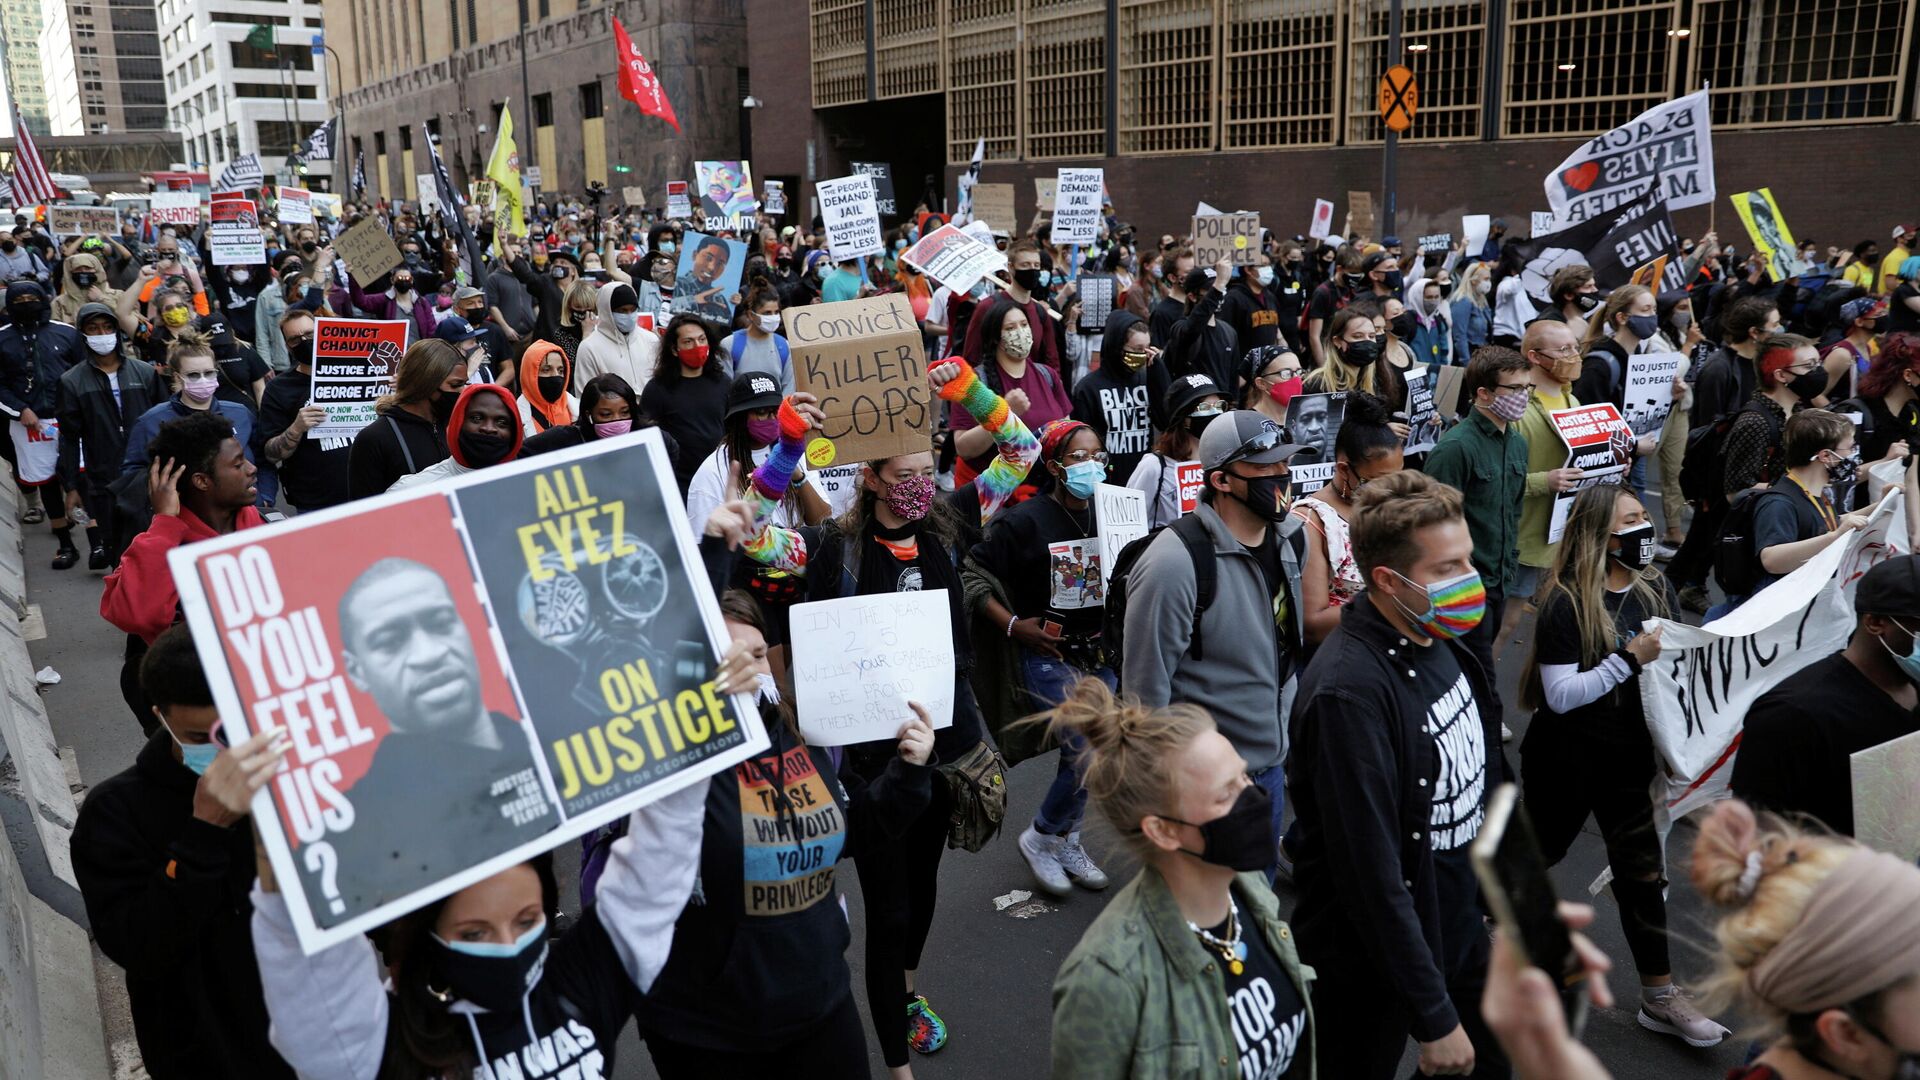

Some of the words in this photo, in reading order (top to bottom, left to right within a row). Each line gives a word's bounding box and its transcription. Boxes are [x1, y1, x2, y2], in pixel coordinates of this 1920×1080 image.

[1384, 90, 1390, 104] R
[1408, 92, 1415, 105] R
[838, 181, 868, 192] PEOPLE
[1061, 184, 1101, 192] DEMAND:
[824, 191, 872, 207] DEMAND:
[1070, 196, 1088, 205] JAIL
[152, 207, 200, 224] BREATHE
[841, 205, 863, 218] JAIL
[338, 218, 381, 250] JUSTICE
[830, 222, 854, 232] KILLER
[834, 226, 875, 242] NOTHING
[1197, 218, 1256, 238] POLICE
[853, 236, 876, 248] LESS!
[362, 254, 393, 279] FLOYD
[923, 248, 954, 271] JUSTICE
[934, 255, 966, 279] GEORGE
[321, 326, 379, 339] CONVICT
[793, 302, 903, 342] Convict
[320, 340, 380, 352] CHAUVIN
[316, 365, 364, 375] JUSTICE
[367, 365, 388, 374] FOR
[806, 345, 918, 389] KILLER
[1631, 364, 1646, 372] NO
[1648, 360, 1679, 373] JUSTICE
[1632, 377, 1646, 385] NO
[1649, 375, 1674, 384] PEACE
[315, 386, 362, 399] GEORGE
[817, 386, 925, 439] COPS
[1558, 412, 1593, 428] JUSTICE
[1590, 410, 1610, 420] FOR
[1562, 423, 1600, 439] GEORGE
[1597, 420, 1626, 432] FLOYD
[1106, 431, 1149, 454] MATTE
[1574, 450, 1614, 468] CONVICT
[819, 468, 856, 478] woma
[532, 464, 598, 520] ALL
[827, 481, 839, 491] to
[516, 500, 640, 582] EYEZ
[204, 545, 286, 628] DO
[805, 610, 840, 632] IN
[850, 606, 883, 625] THE
[890, 600, 926, 626] YEAR
[228, 605, 336, 698] YOU
[801, 664, 851, 683] WILL
[600, 657, 659, 716] ON
[828, 690, 853, 706] BE
[864, 678, 914, 699] PROUD
[813, 713, 860, 730] THEIR
[863, 708, 909, 722] FAMIL
[865, 702, 885, 714] OF
[252, 675, 374, 772] FEEL
[551, 680, 736, 800] JUSTICE
[490, 767, 537, 796] JUSTICE
[568, 784, 622, 813] JUSTICE
[626, 772, 651, 788] FOR
[655, 751, 702, 775] GEORGE
[705, 731, 742, 754] FLOYD
[276, 758, 356, 844] US
[517, 781, 540, 799] FOR
[501, 794, 545, 818] GEORGE
[512, 804, 550, 827] FLOYD
[777, 845, 824, 876] YOUR
[305, 841, 347, 914] ?
[751, 868, 834, 910] PRIVILEGE
[522, 1019, 596, 1078] WAS
